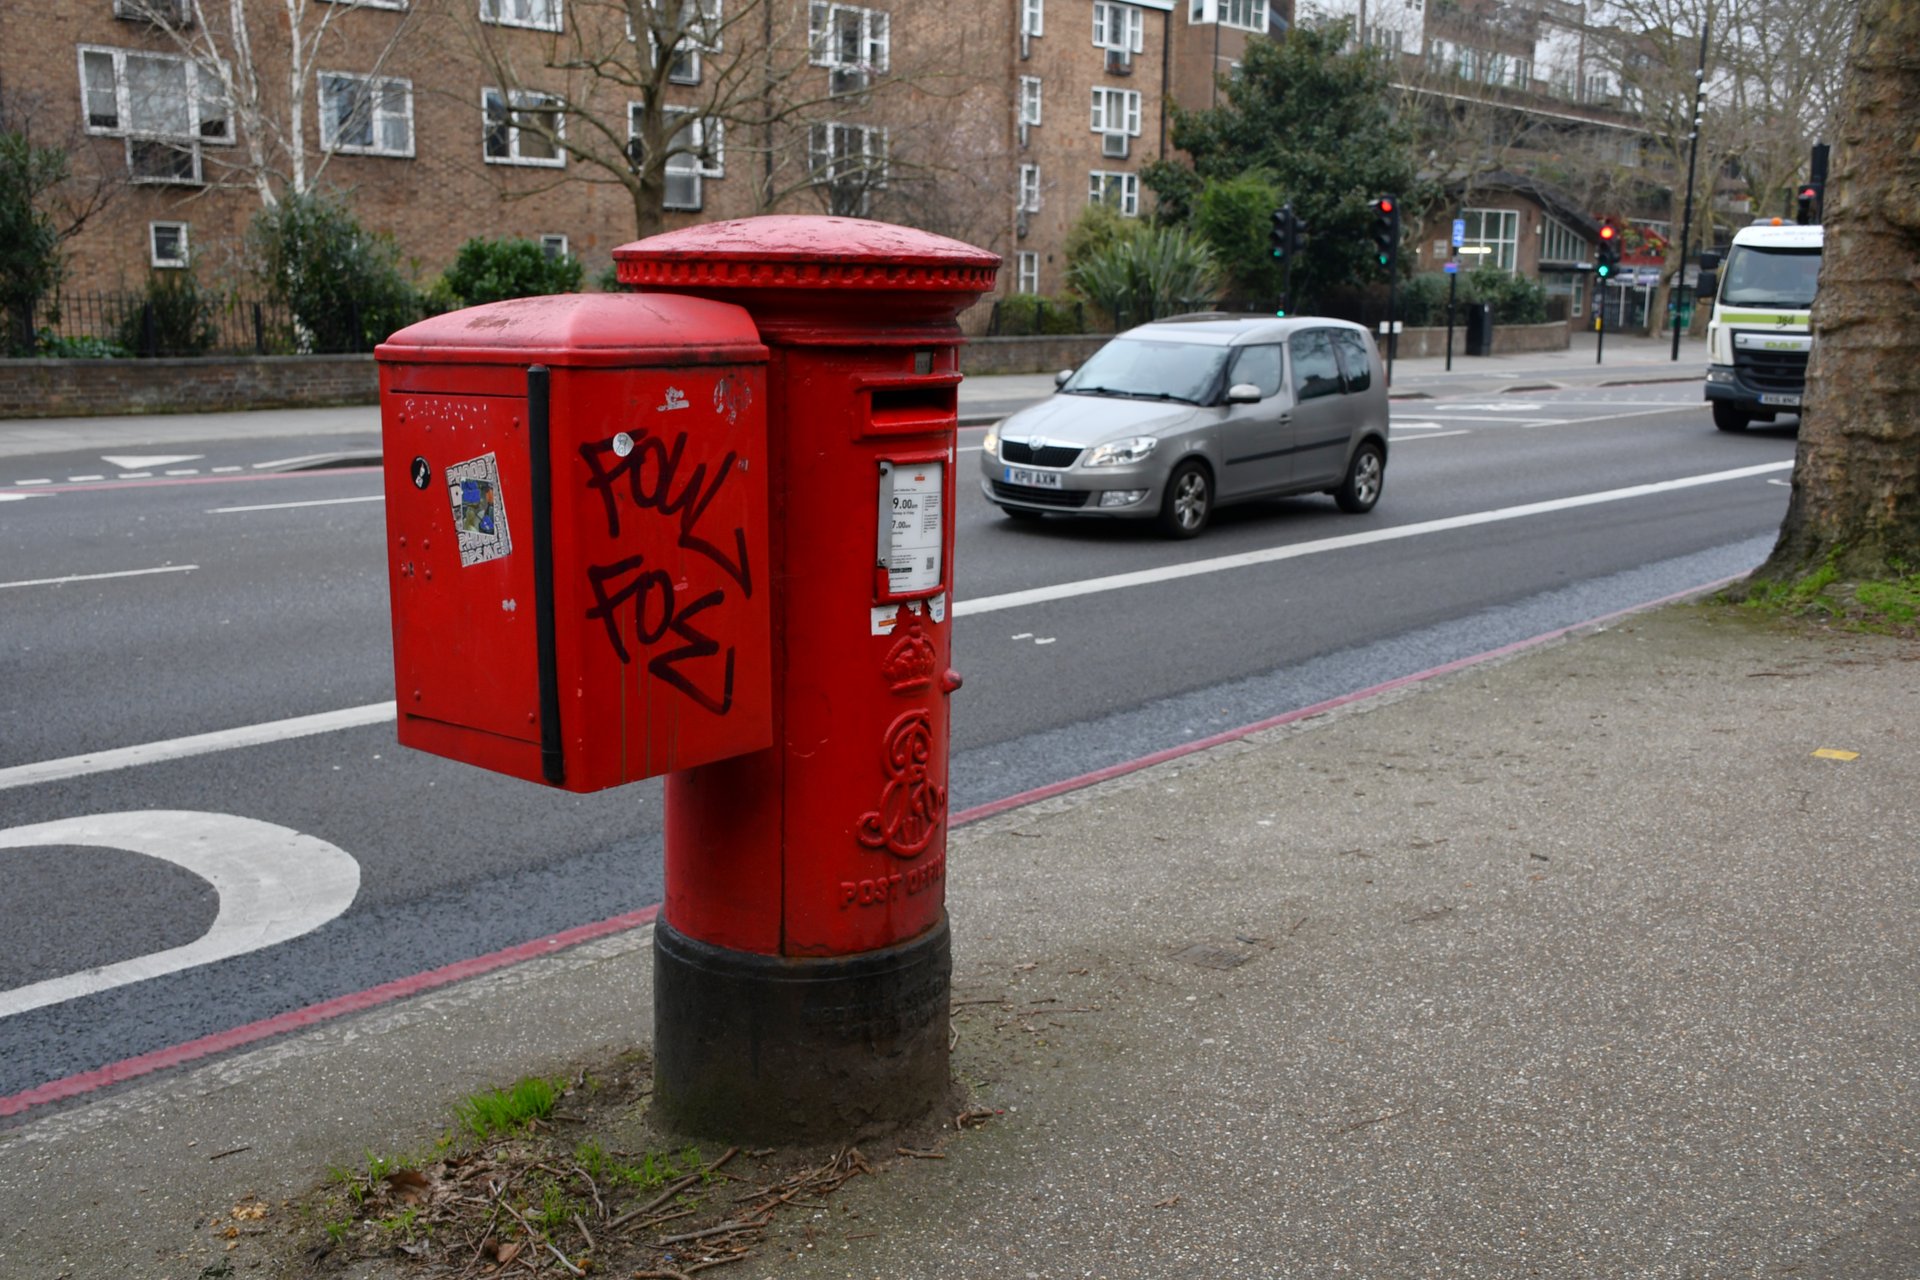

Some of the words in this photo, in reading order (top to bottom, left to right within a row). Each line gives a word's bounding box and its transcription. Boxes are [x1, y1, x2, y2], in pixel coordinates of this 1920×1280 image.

[1764, 341, 1802, 349] DAF
[1035, 471, 1057, 486] AXM
[840, 873, 903, 910] POST
